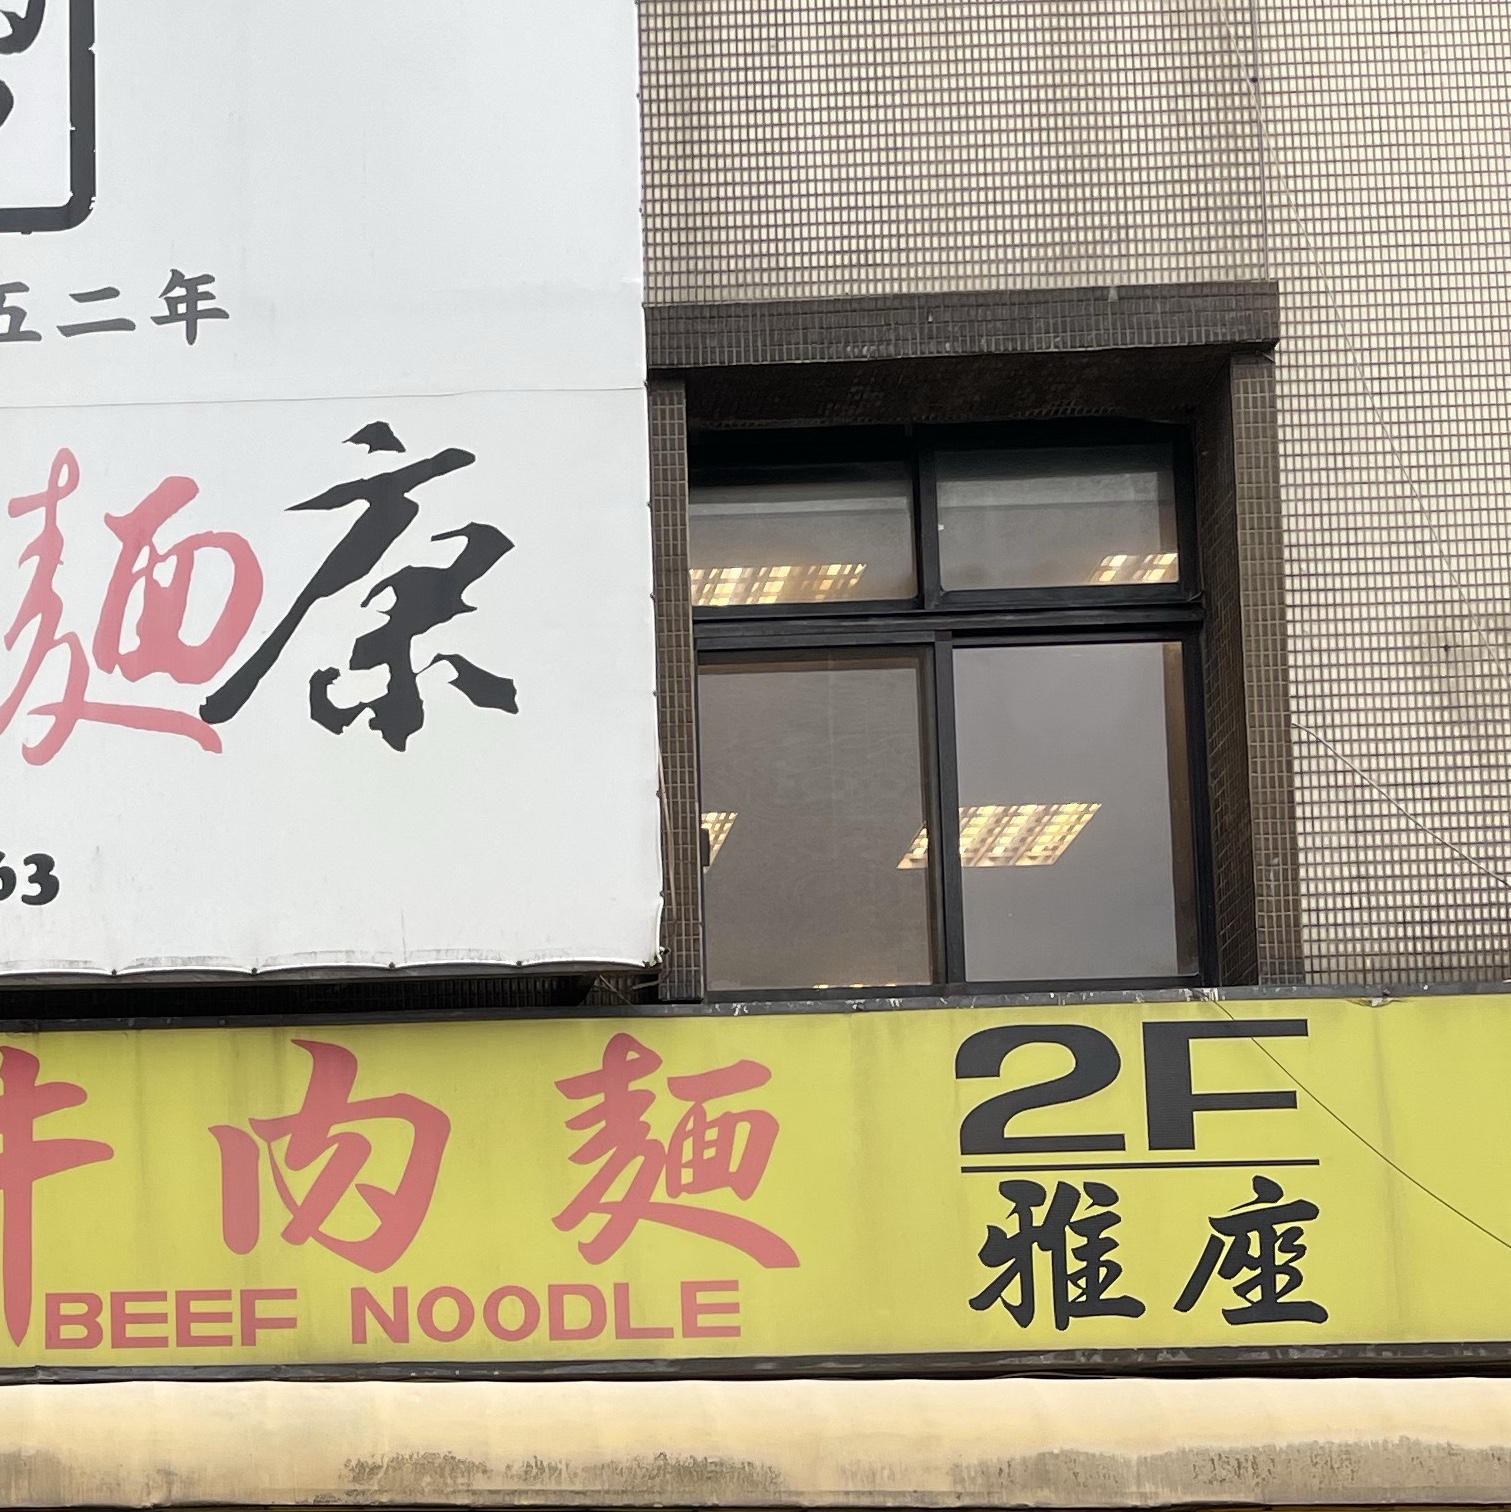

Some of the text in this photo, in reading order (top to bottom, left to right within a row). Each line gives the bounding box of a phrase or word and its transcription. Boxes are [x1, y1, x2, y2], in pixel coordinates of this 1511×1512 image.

[955, 1018, 1308, 1155] 2F
[44, 1287, 299, 1351] BEEF
[350, 1278, 743, 1346] NOODLE
[968, 1175, 1329, 1331] 雅座
